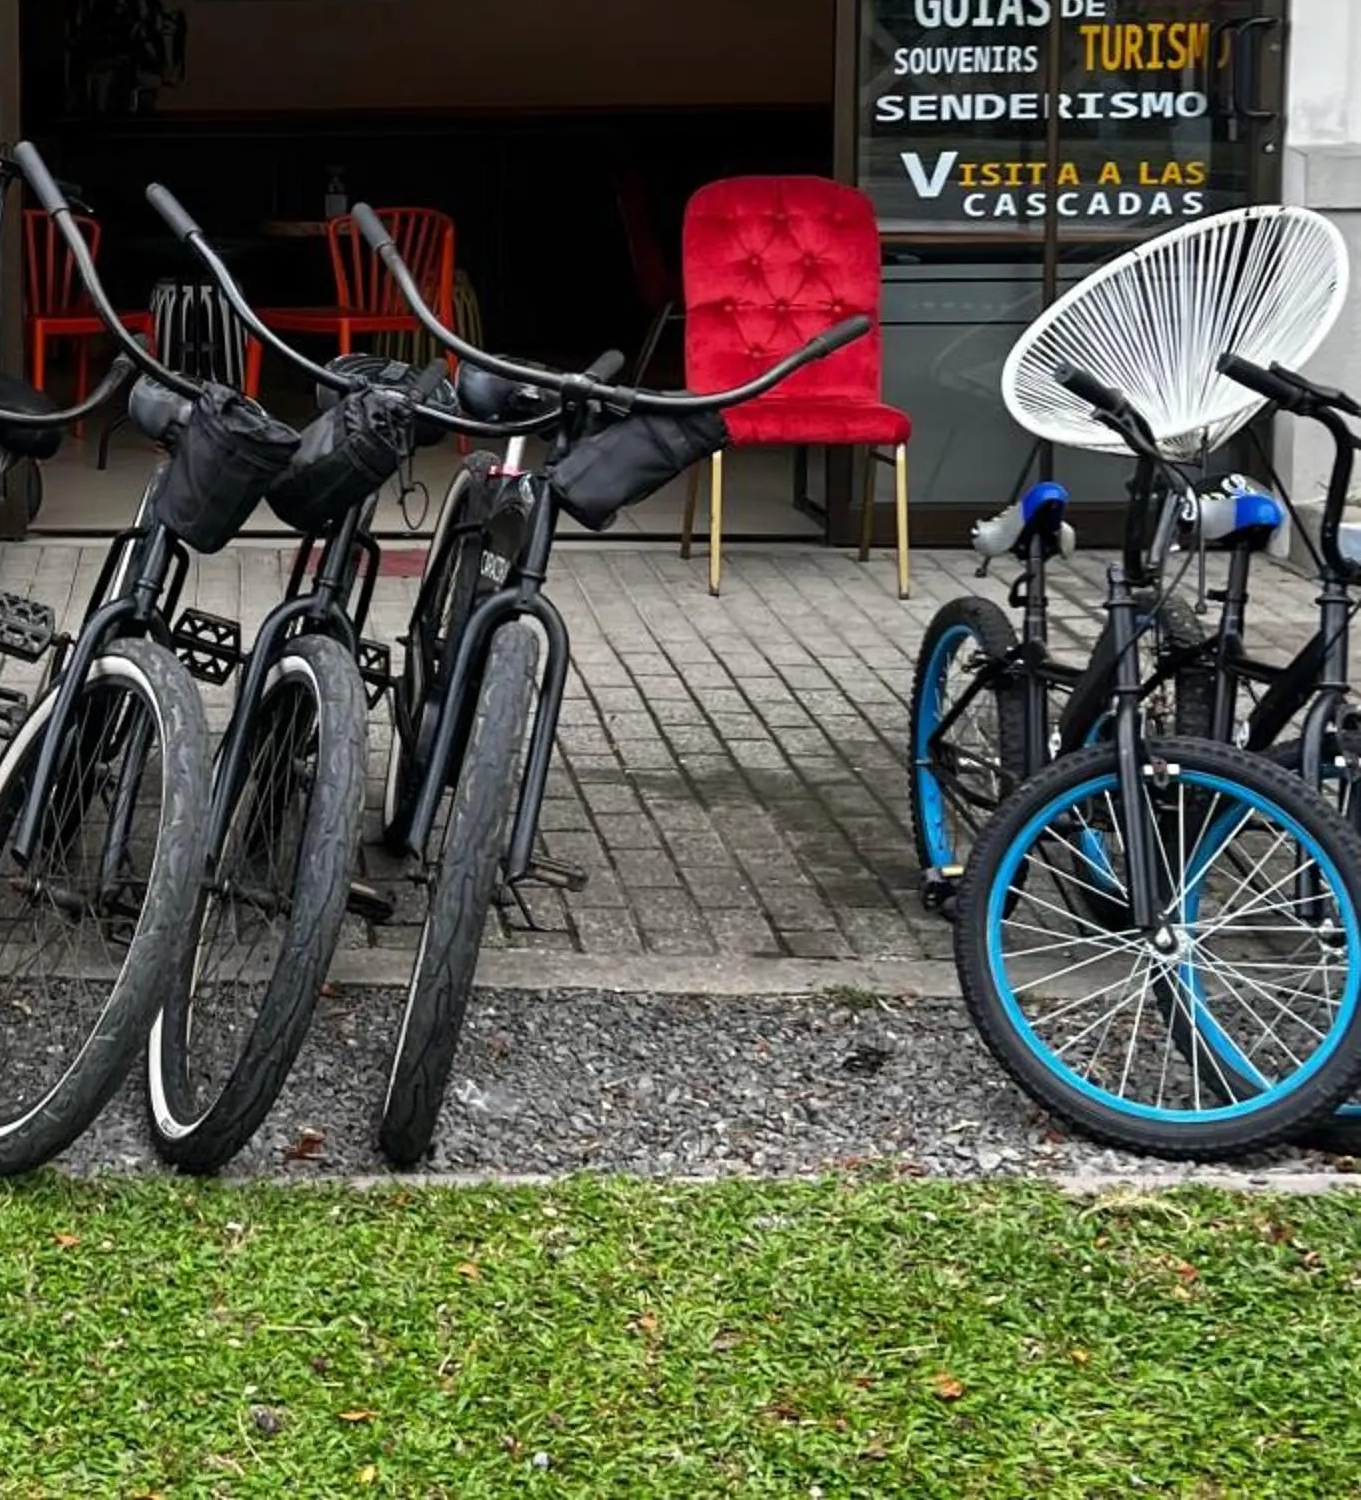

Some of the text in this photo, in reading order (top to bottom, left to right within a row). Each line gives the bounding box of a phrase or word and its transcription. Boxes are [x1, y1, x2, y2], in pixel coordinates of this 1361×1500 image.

[894, 45, 1038, 75] SOUVENIRS
[1099, 162, 1120, 185] A
[1140, 161, 1205, 185] LAS
[963, 192, 1203, 217] CASCADAS
